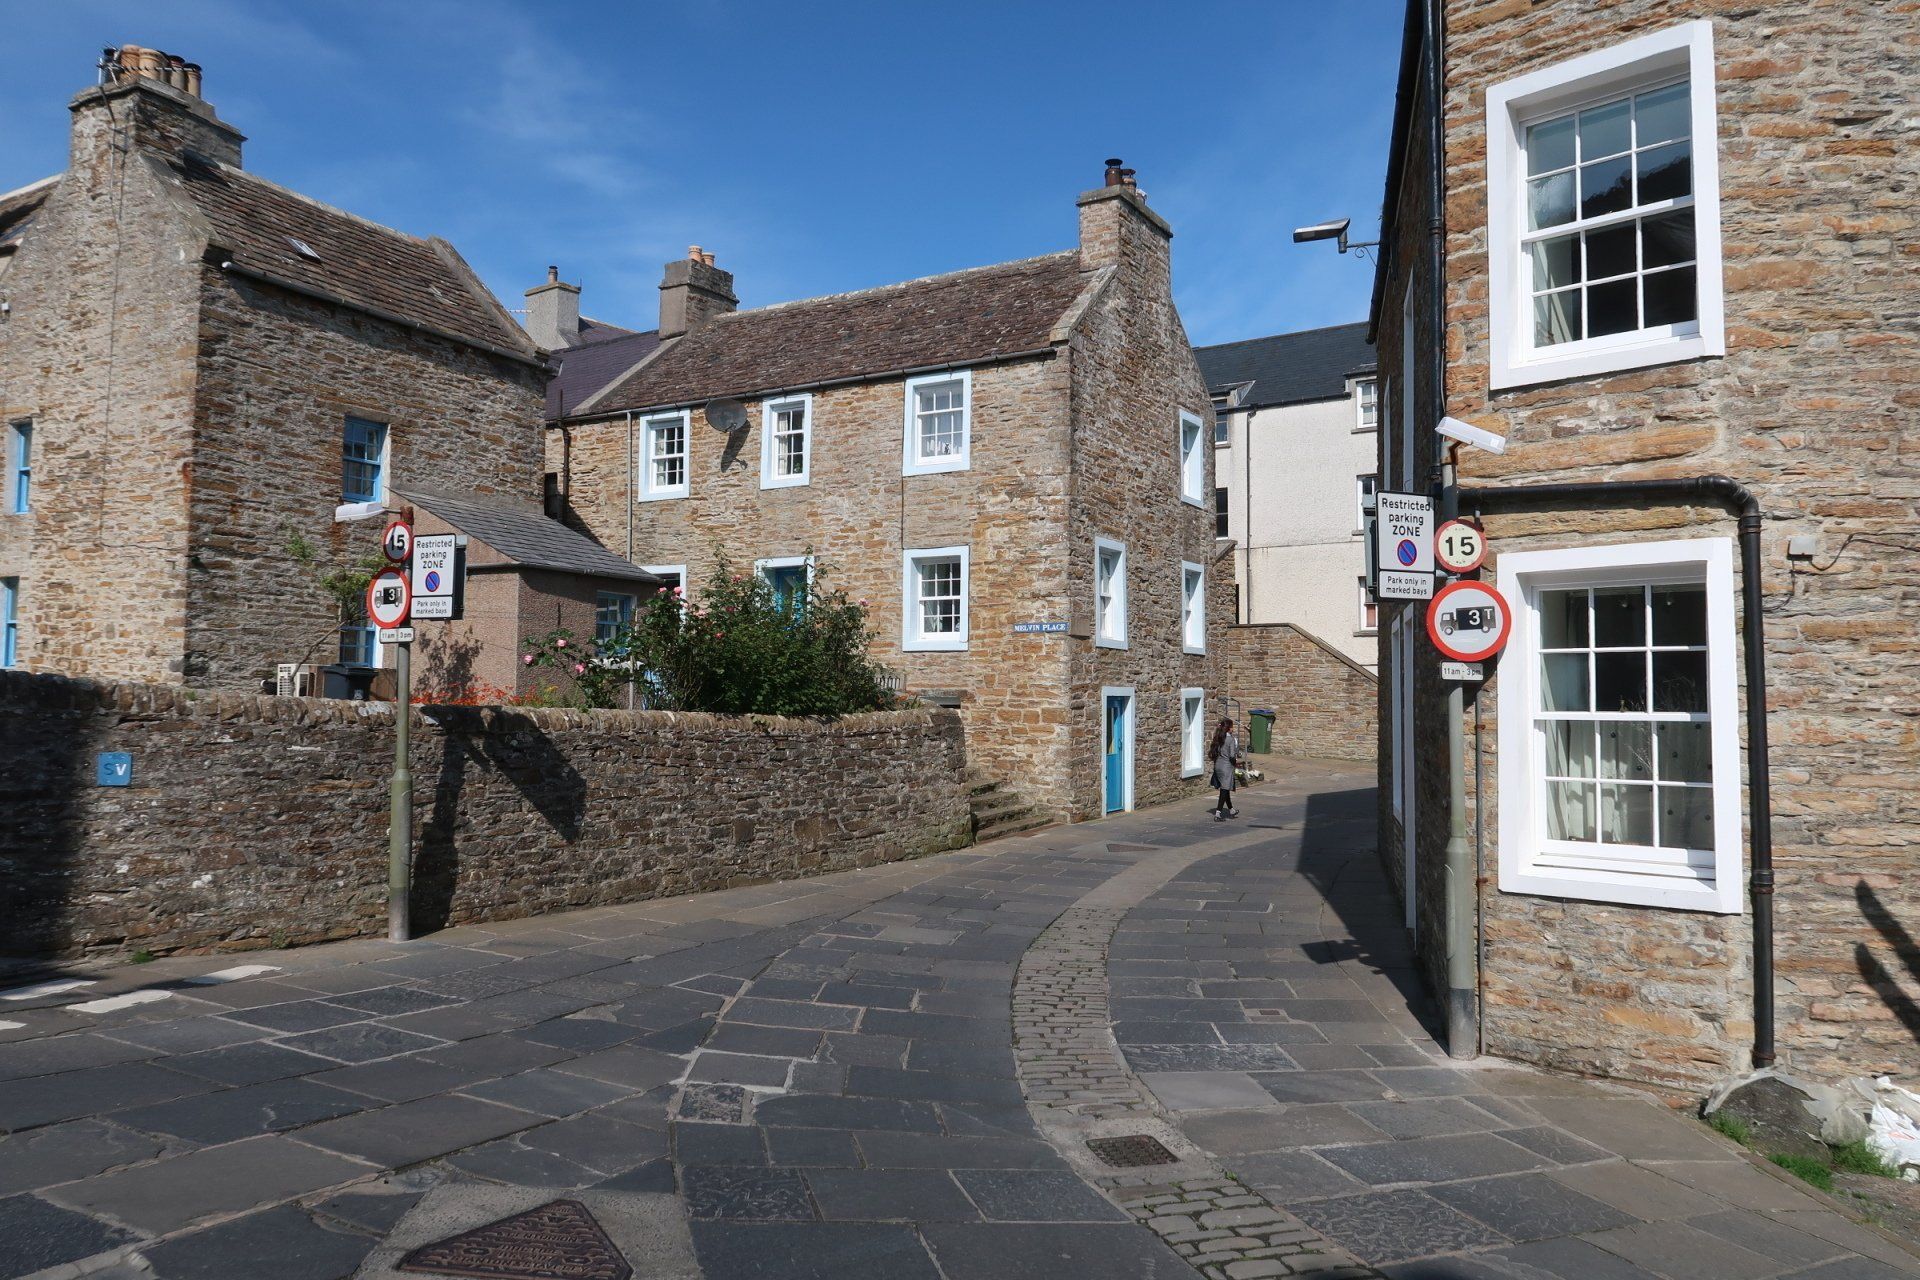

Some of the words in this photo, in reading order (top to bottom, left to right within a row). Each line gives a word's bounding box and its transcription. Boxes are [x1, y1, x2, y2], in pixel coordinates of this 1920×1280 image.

[1382, 497, 1431, 512] Restricted
[1388, 513, 1424, 525] parking
[1392, 525, 1421, 537] ZONE
[391, 534, 405, 550] 15
[416, 539, 453, 549] Restricted
[1445, 536, 1475, 556] 15
[420, 550, 447, 560] parking
[423, 560, 444, 569] ZONE
[1387, 575, 1403, 584] Park
[1404, 577, 1419, 586] only
[1420, 577, 1427, 585] in
[1385, 586, 1411, 595] marked
[1412, 587, 1427, 596] bays
[1014, 624, 1041, 632] MELVIN
[1042, 623, 1066, 631] PLACE
[1443, 667, 1461, 675] 11am
[103, 763, 127, 776] SV
